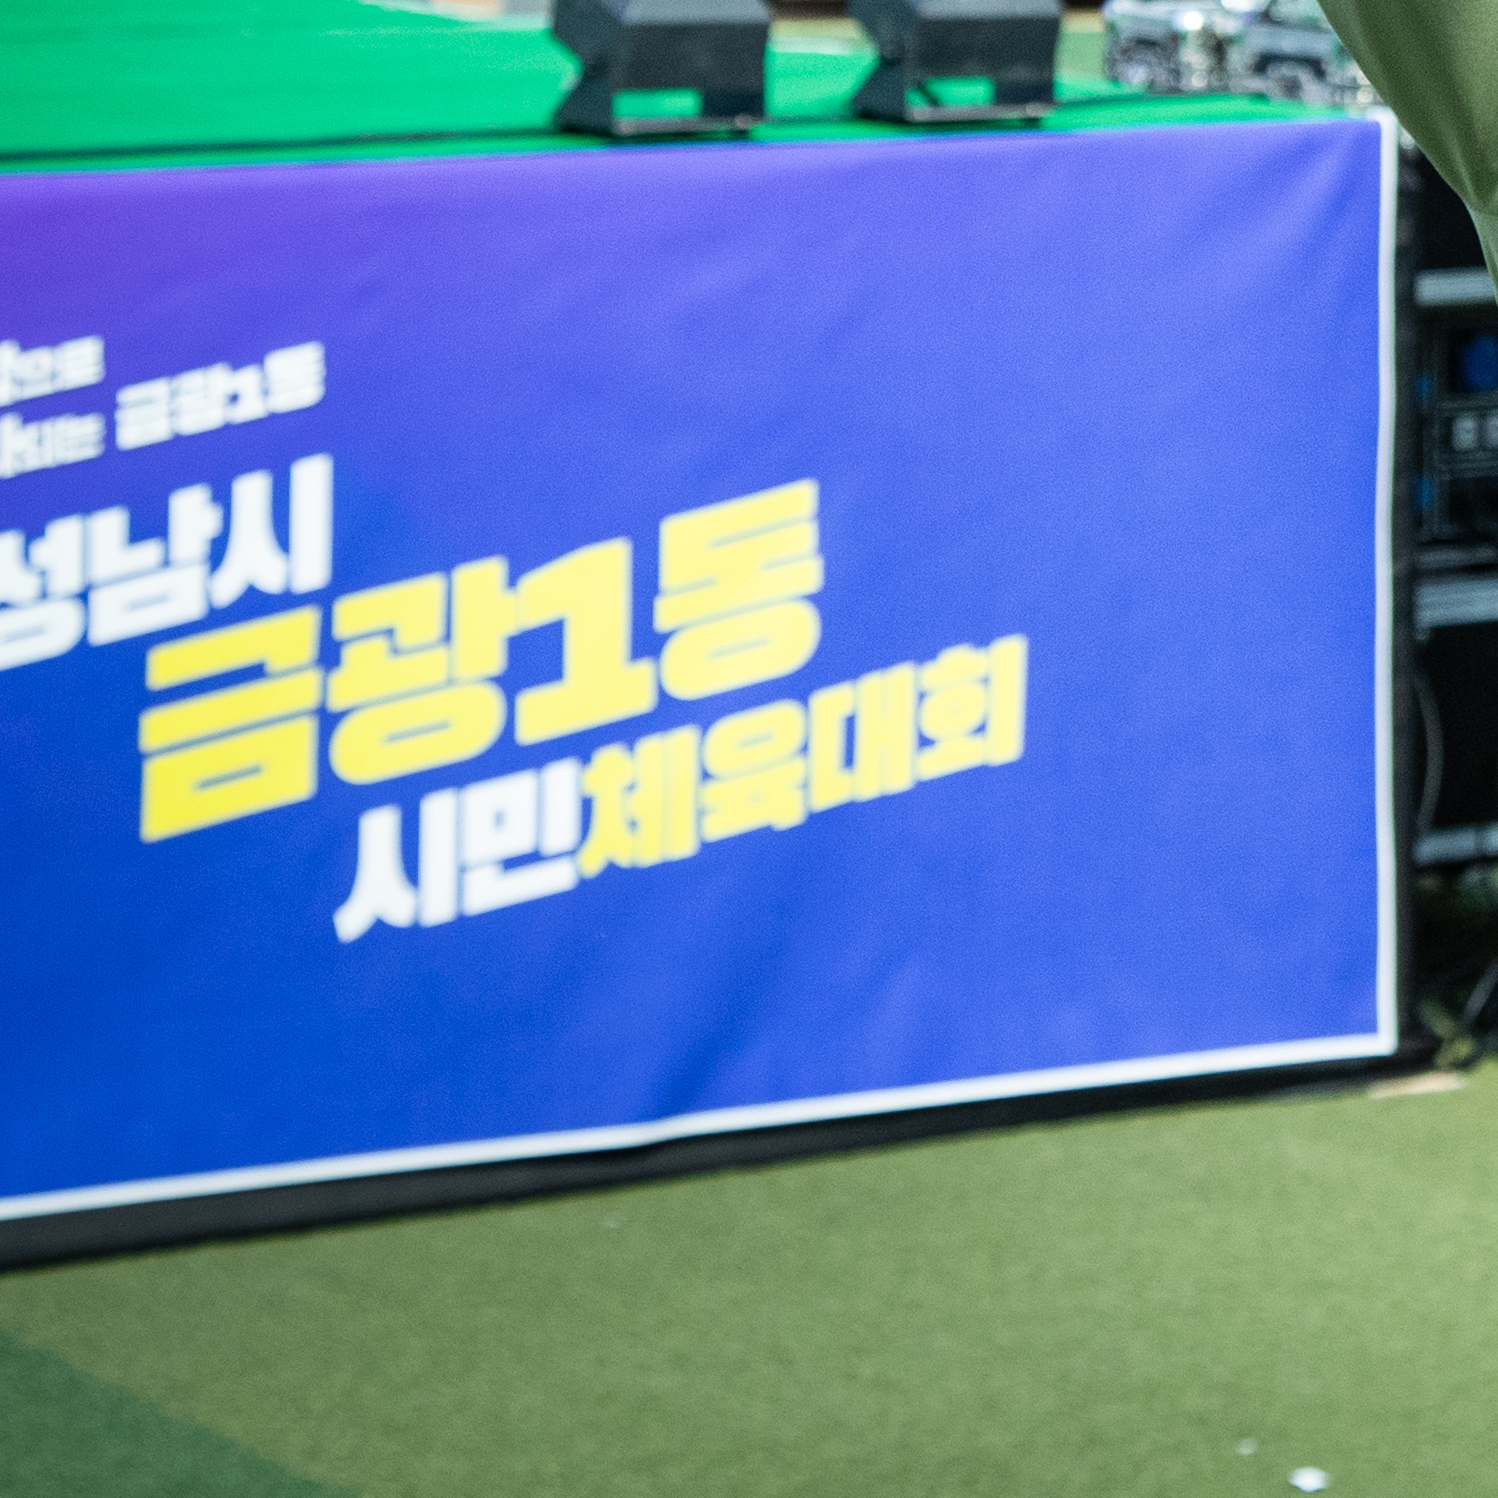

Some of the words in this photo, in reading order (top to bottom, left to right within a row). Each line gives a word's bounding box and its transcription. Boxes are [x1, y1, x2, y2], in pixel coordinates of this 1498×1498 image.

[0, 335, 106, 406] 으로
[115, 340, 327, 450] 금광1동
[0, 452, 334, 671] 성남시
[138, 478, 824, 843] 금광1동
[332, 633, 1029, 944] 시민체육대회
